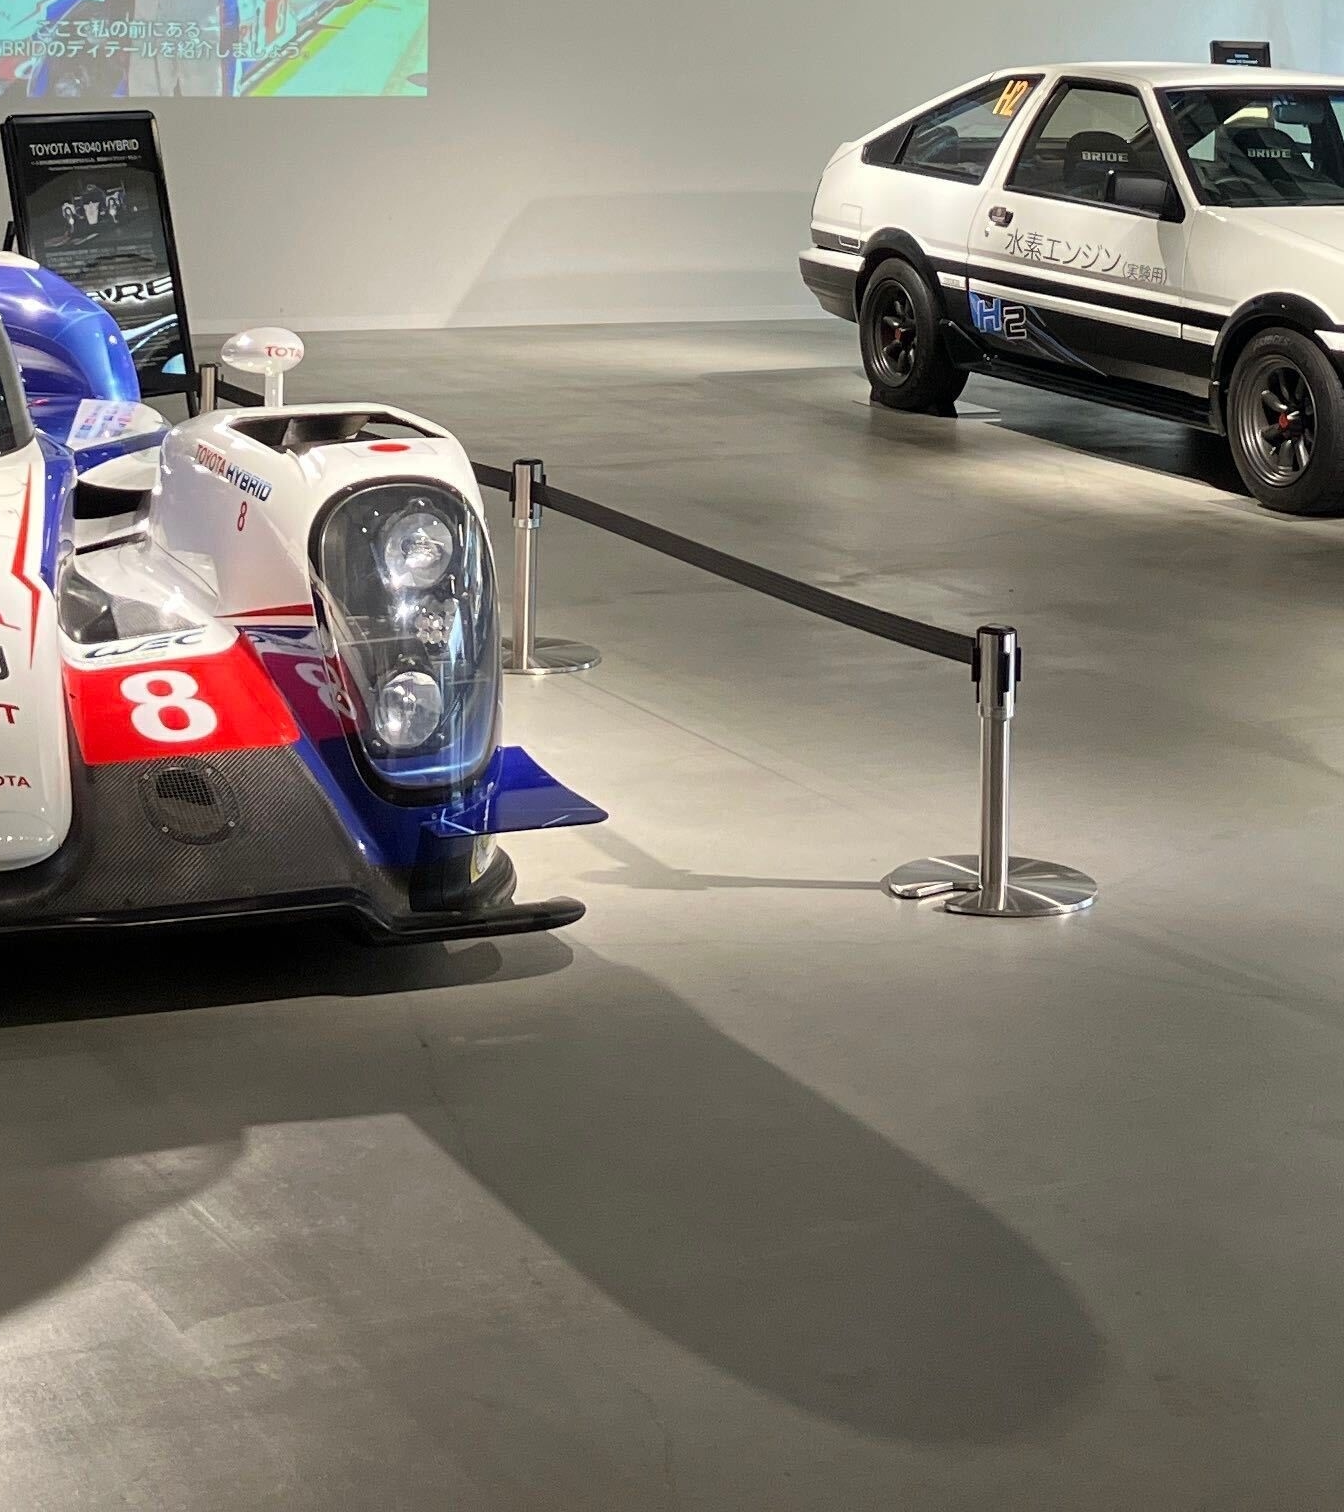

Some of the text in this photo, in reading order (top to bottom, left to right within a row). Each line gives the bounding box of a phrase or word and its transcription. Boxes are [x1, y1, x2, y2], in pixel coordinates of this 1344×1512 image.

[36, 19, 201, 39] ここで私の前にある
[992, 80, 1028, 117] H2
[29, 139, 140, 156] TOYOTA TS040 HYBRID
[1081, 150, 1130, 163] BRIDE
[1005, 227, 1122, 273] 水素エンジン
[194, 442, 273, 503] TOYOTA HYBRID
[236, 500, 248, 532] 8
[119, 669, 219, 743] 8
